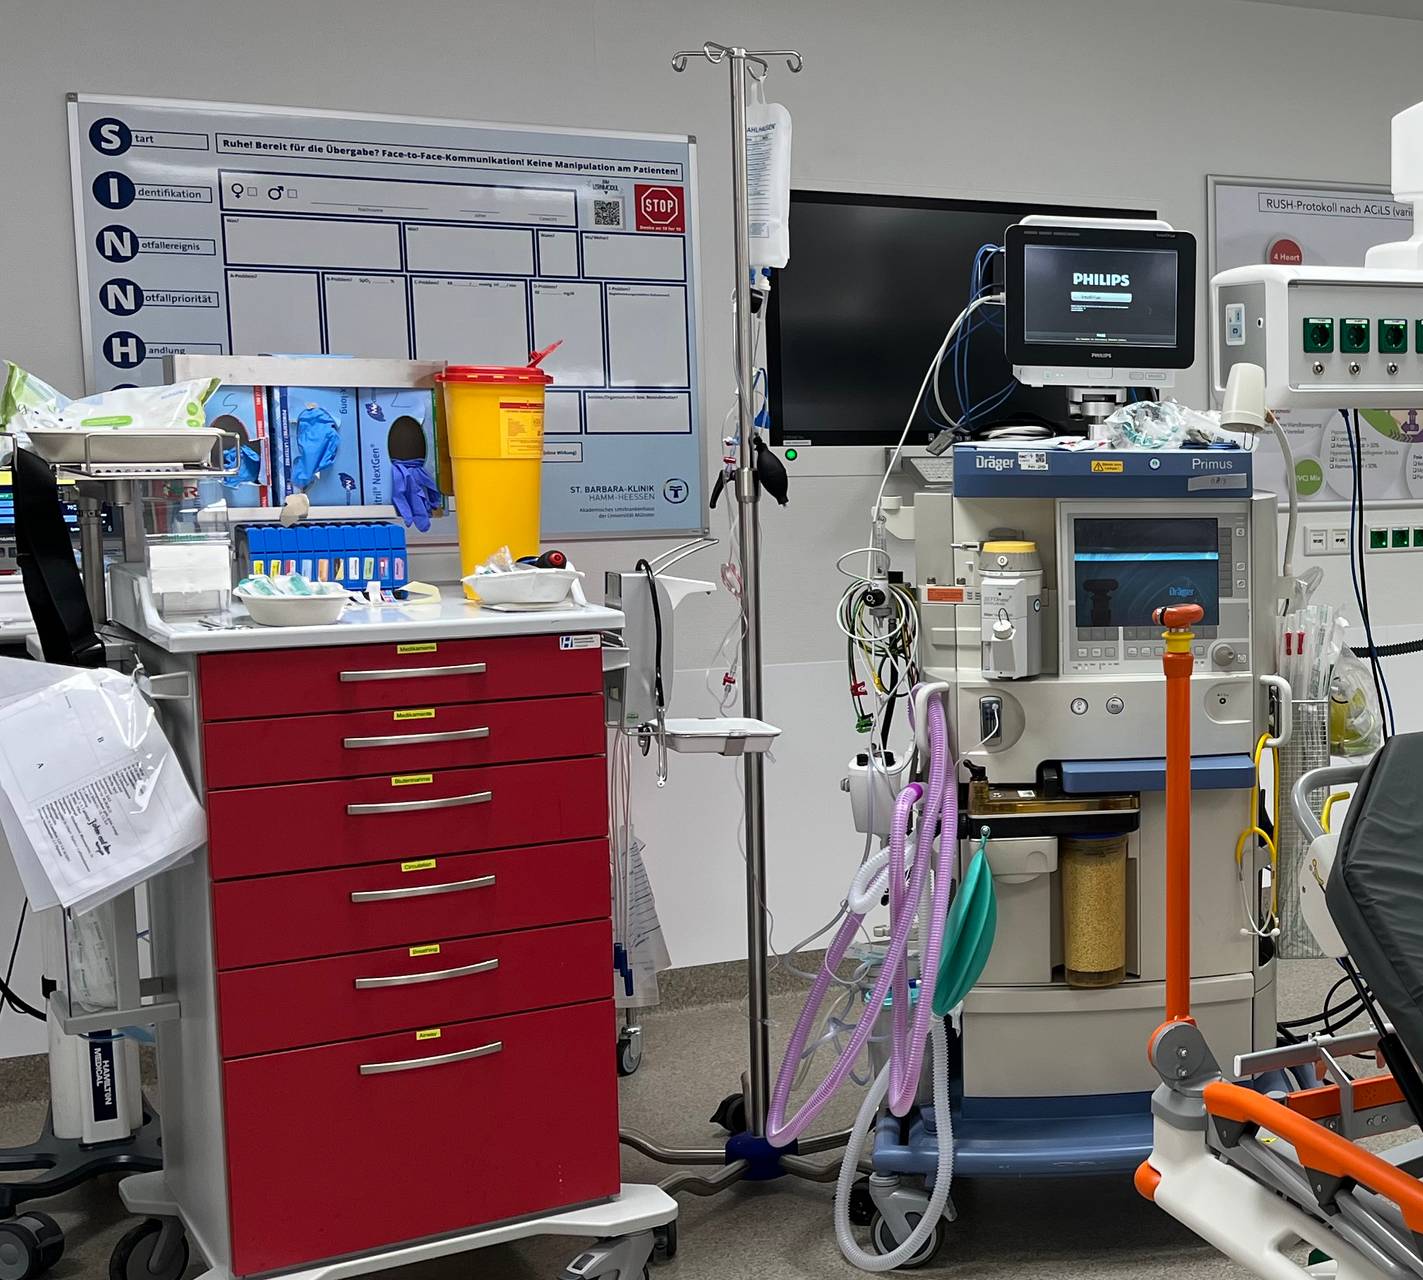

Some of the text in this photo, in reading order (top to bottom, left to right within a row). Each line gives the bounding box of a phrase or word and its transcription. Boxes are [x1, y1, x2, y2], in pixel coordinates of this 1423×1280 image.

[223, 139, 679, 176] Ruhe! Bereit für die Übergabe? Face-to-Face-Kommunikation! Keine Manipulation am Patienten!
[138, 188, 201, 198] dentifikation
[645, 199, 674, 213] STOP
[1266, 199, 1338, 213] RUSH-Protokoll
[1340, 204, 1361, 214] nach
[1364, 204, 1391, 216] ACiLS
[141, 241, 200, 252] otfallereignis
[1280, 253, 1300, 261] Heart
[1072, 272, 1130, 287] PHILIPS
[145, 293, 212, 304] otfallpriorität
[149, 347, 186, 355] andlung
[976, 455, 1015, 471] Dräger
[1192, 458, 1233, 470] Primus
[570, 486, 582, 494] ST.
[584, 485, 655, 493] BARBARA-KLINIK
[589, 493, 655, 501] HAMM-HEESSEN
[1169, 586, 1195, 597] Dräger
[94, 1047, 103, 1087] MEDICAL
[102, 1060, 113, 1106] HAMILTON
